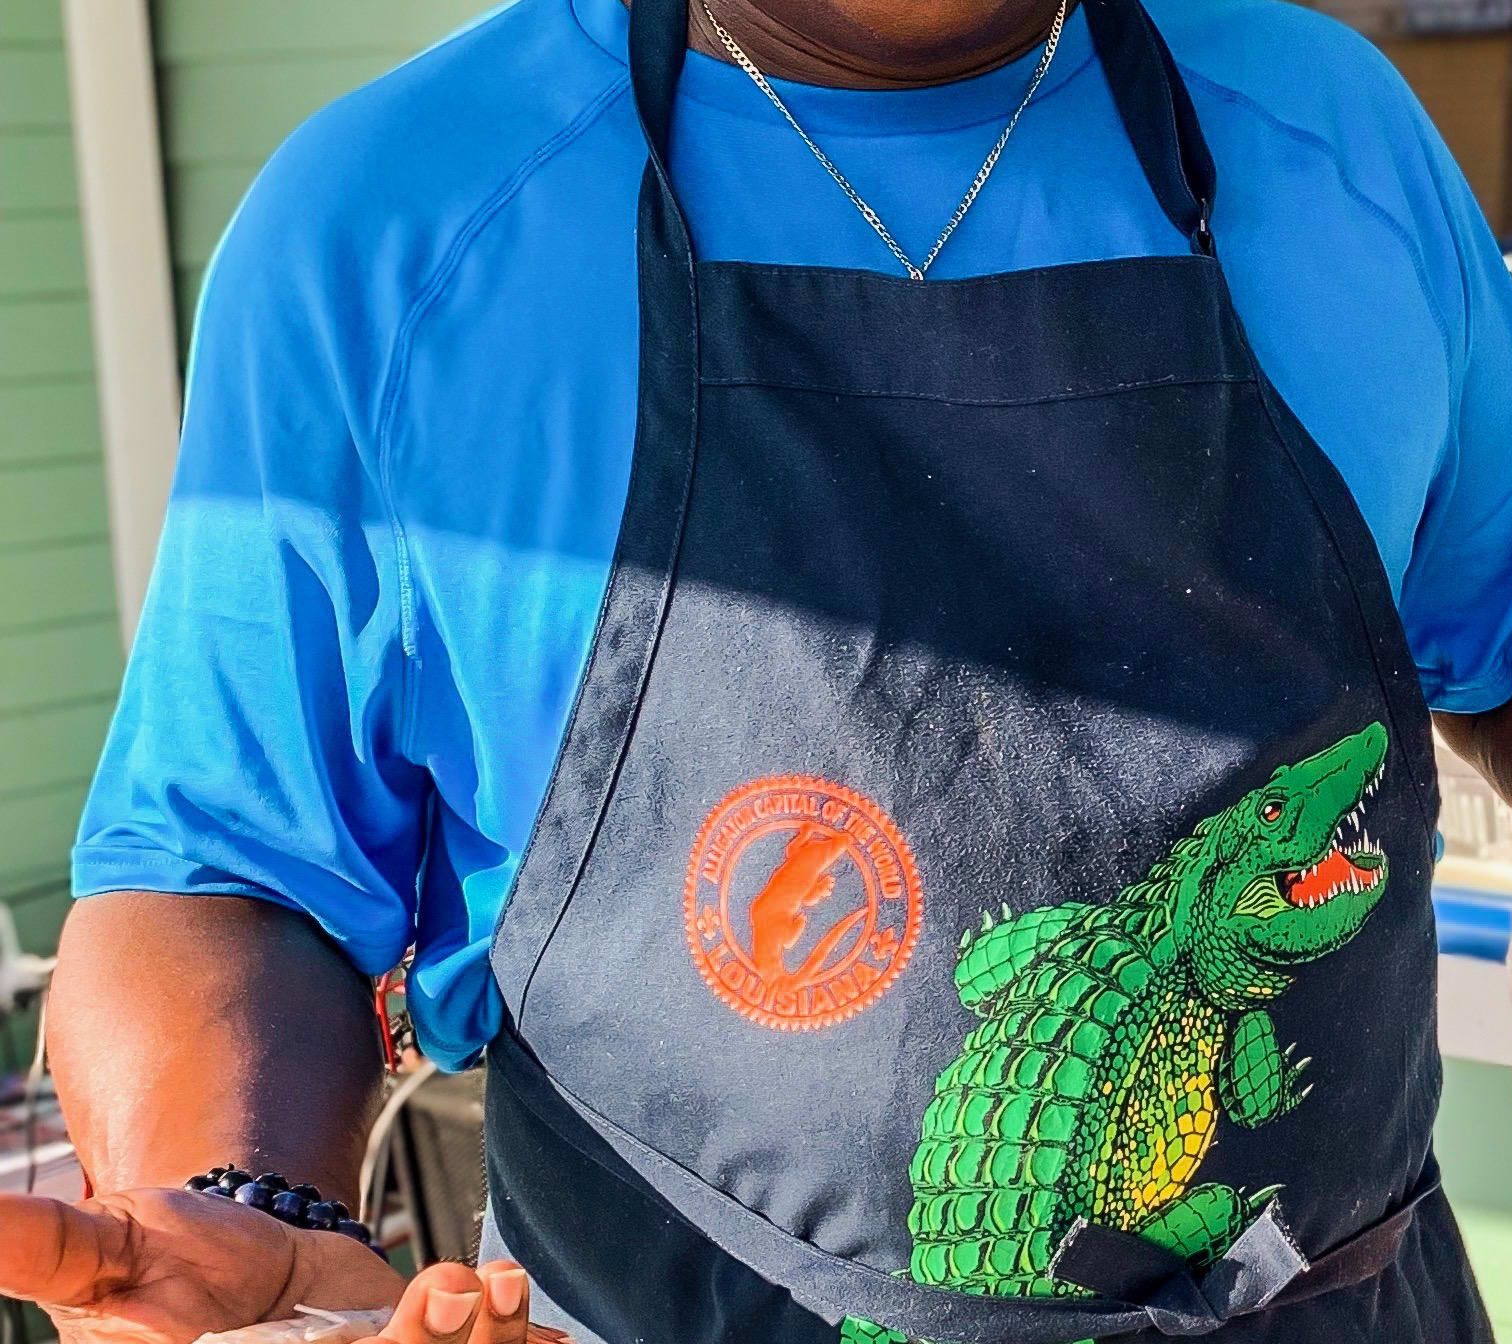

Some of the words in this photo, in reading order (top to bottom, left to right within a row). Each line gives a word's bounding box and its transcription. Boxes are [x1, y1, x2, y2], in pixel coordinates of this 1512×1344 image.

[702, 811, 754, 886] ALLIGATOR
[753, 793, 820, 822] CAPITAL
[821, 798, 851, 824] OF
[843, 811, 878, 846] THE
[867, 837, 903, 900] WORLD
[706, 942, 884, 1017] LOUISIANA
